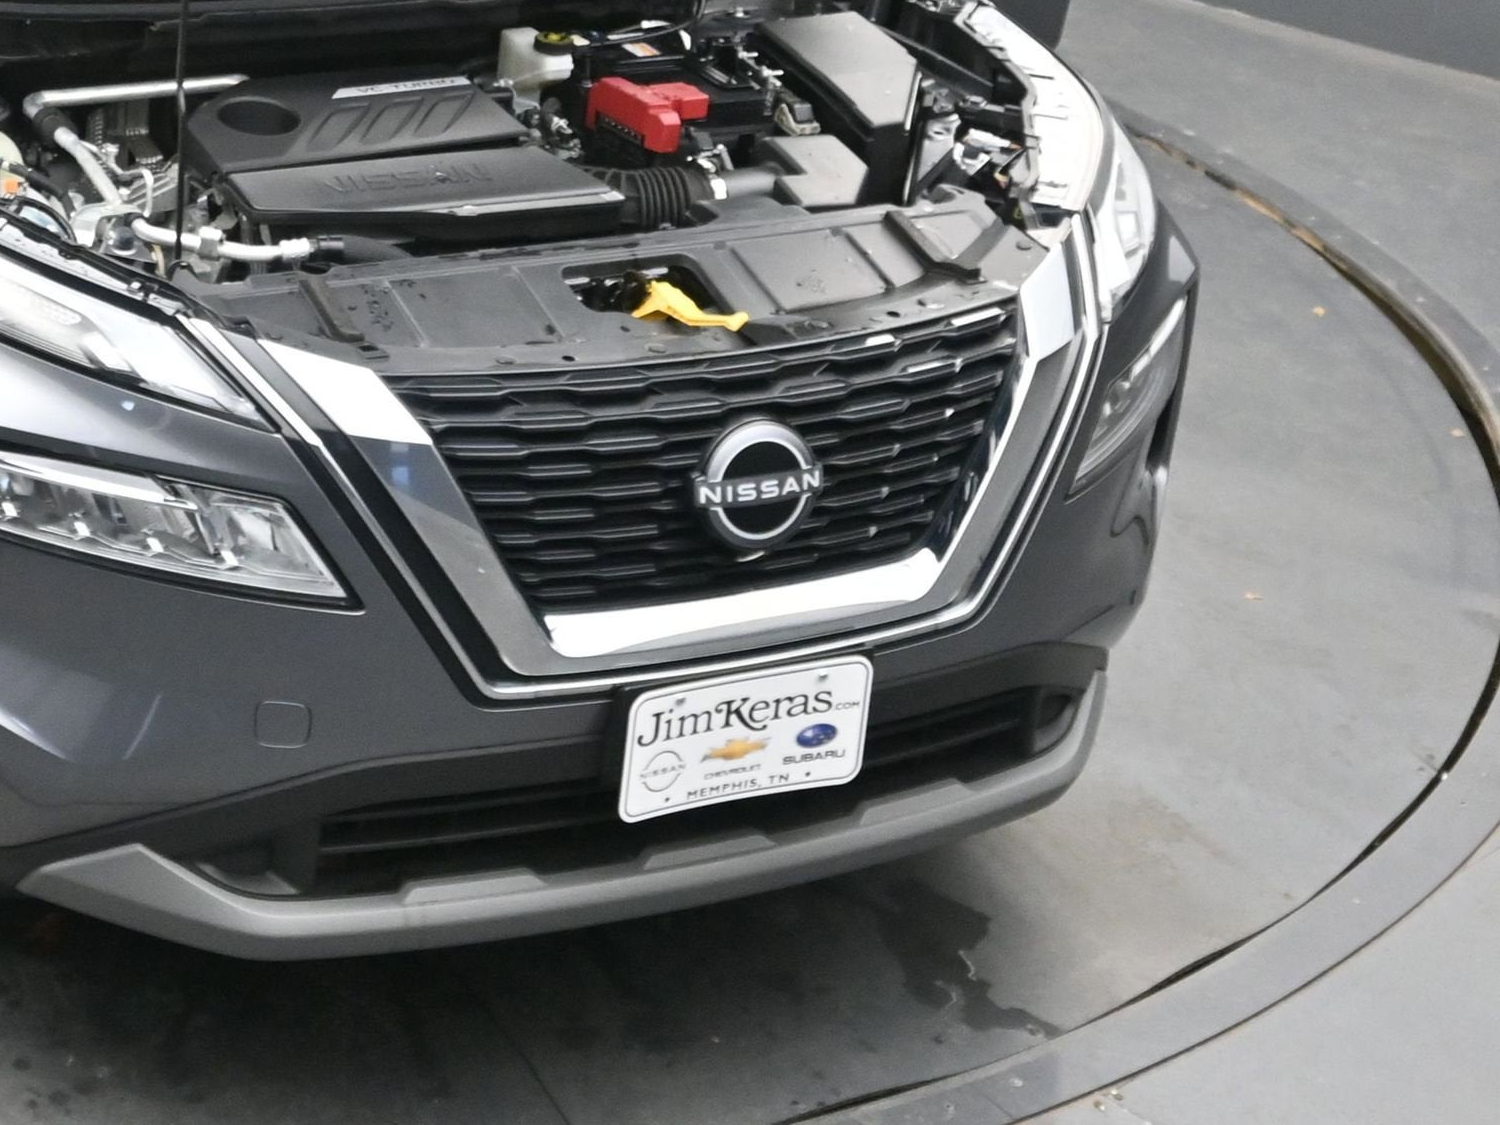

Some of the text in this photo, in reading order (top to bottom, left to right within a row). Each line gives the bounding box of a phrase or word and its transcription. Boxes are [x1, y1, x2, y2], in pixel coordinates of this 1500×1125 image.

[699, 469, 821, 505] NISSAN
[782, 749, 846, 765] SUBARU
[703, 763, 762, 781] CHEVROLET
[768, 773, 790, 784] TN
